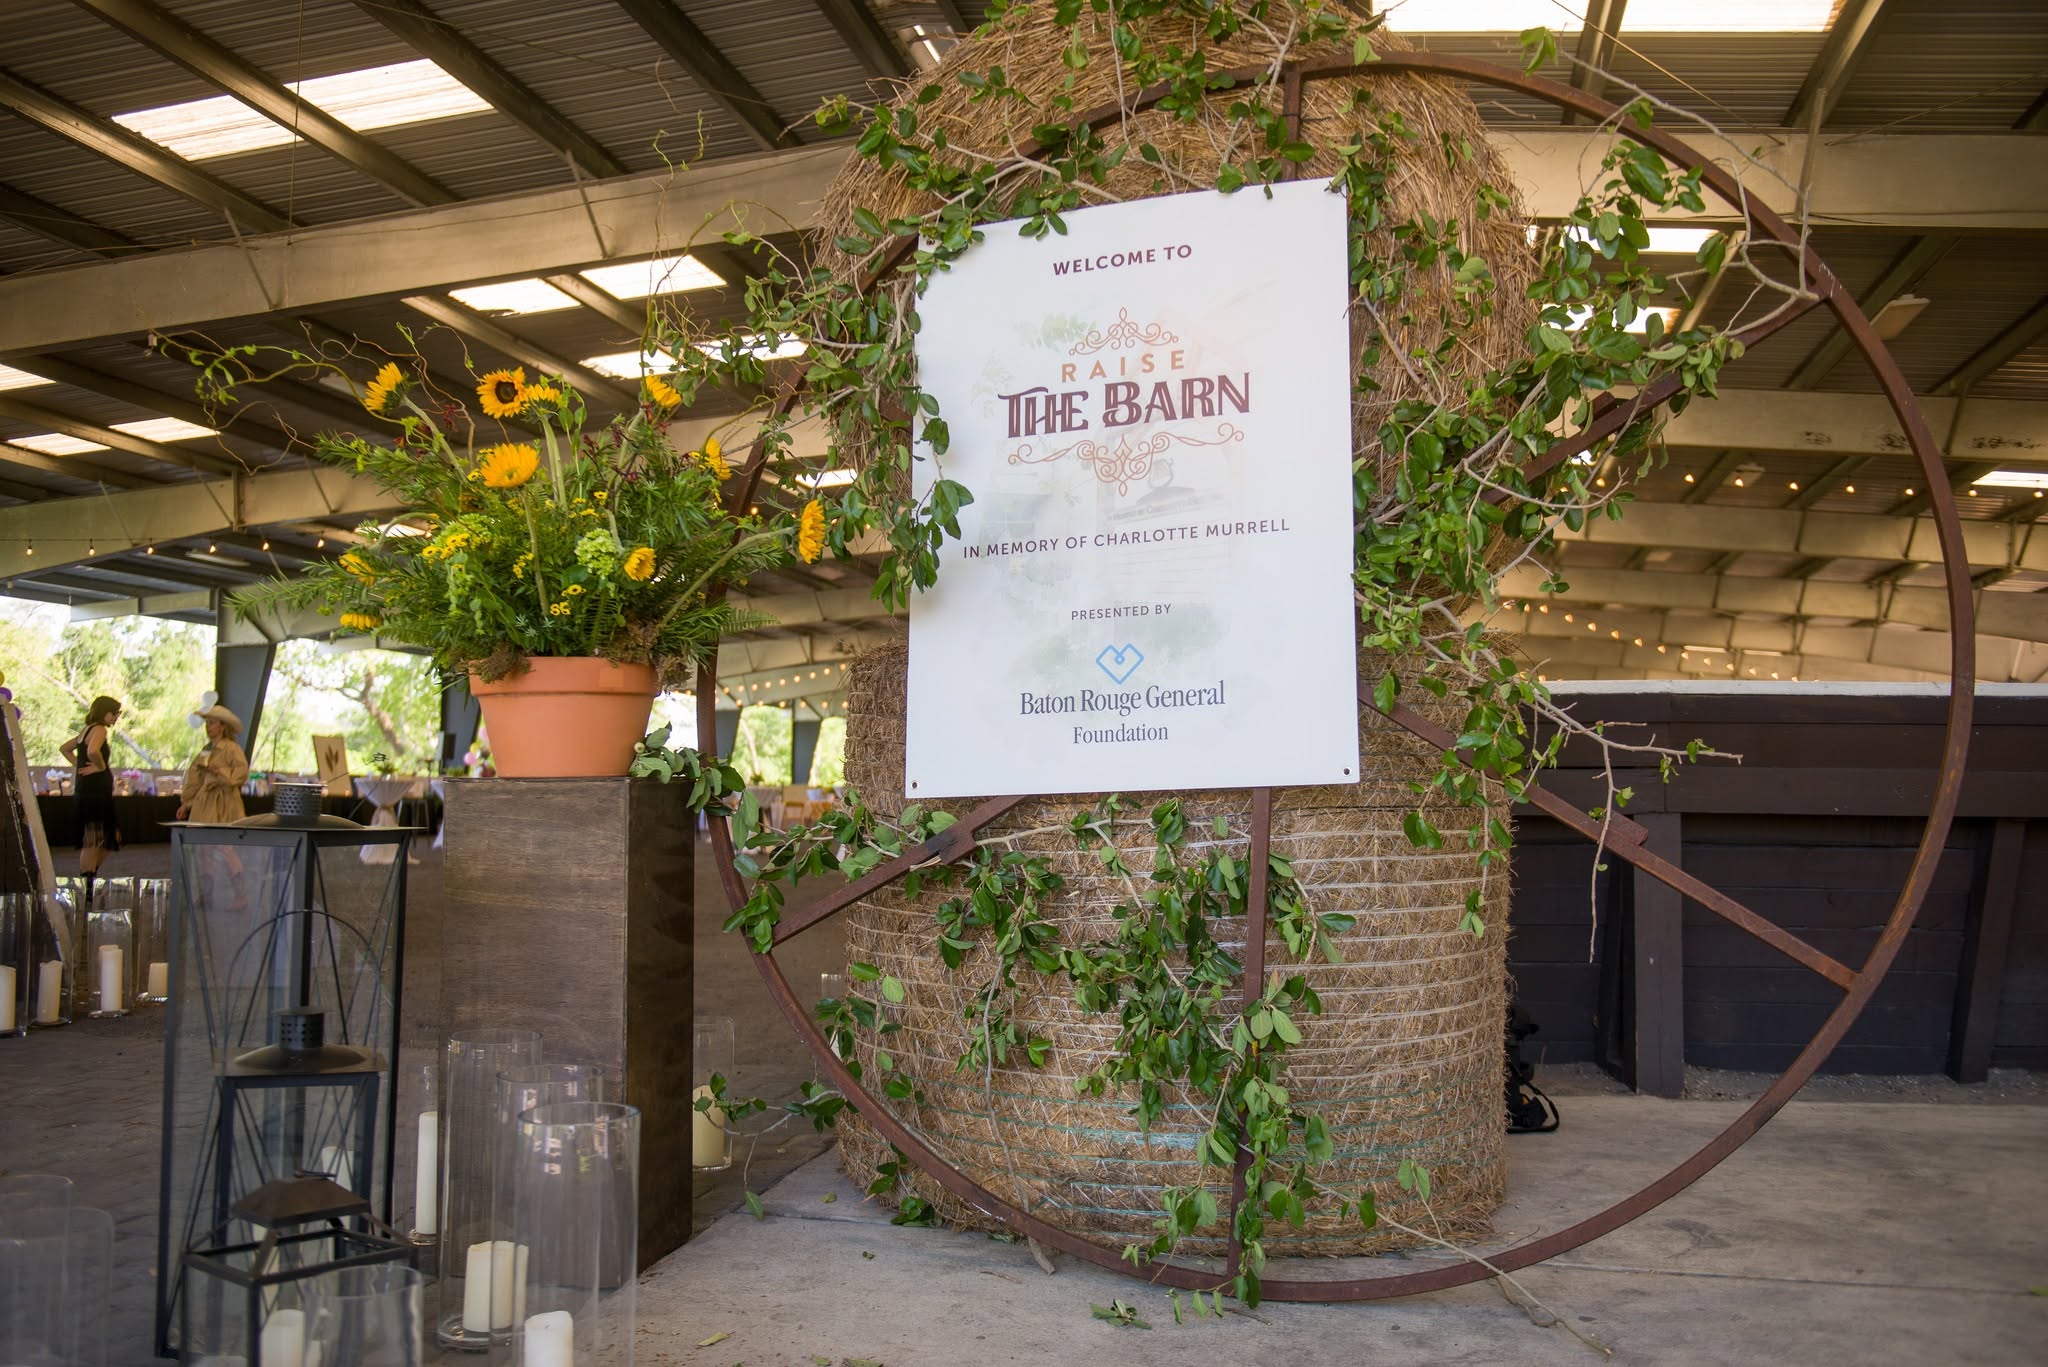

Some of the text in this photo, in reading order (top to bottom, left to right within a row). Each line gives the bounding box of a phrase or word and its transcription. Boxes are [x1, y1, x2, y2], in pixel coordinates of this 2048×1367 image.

[1053, 244, 1193, 276] WELCOME TO
[1062, 349, 1186, 383] RAISE
[997, 372, 1251, 438] THE BARN
[963, 518, 1290, 559] IN MEMORY OF CHARLOTTE MURRELL
[1071, 603, 1172, 621] PRESENTED BY
[1020, 681, 1226, 717] Baton Rouge General
[1073, 723, 1169, 744] Foundation
